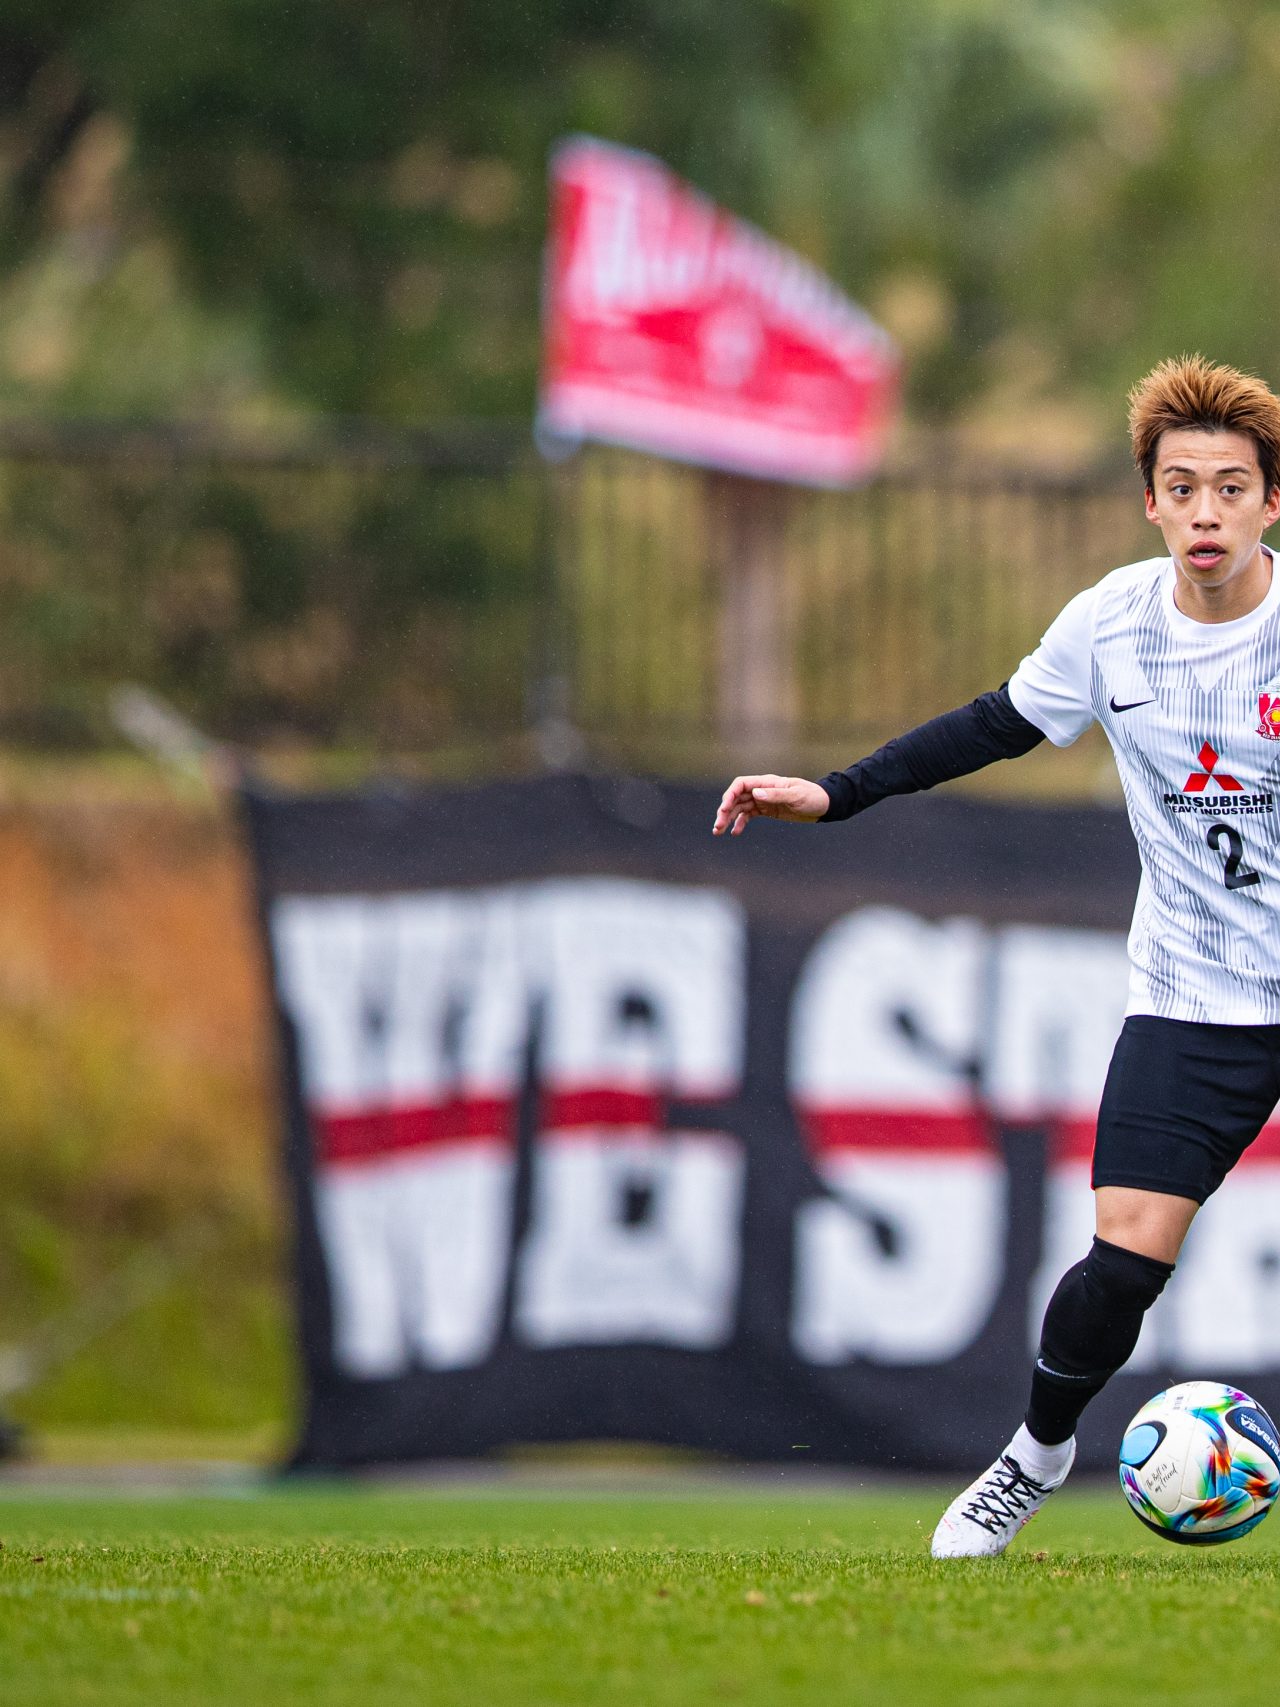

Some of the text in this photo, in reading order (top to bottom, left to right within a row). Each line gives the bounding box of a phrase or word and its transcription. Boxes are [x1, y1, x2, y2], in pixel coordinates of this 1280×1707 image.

[1163, 793, 1273, 808] MITSUBISHI
[1201, 805, 1274, 816] INDUSTRIES
[1206, 824, 1261, 890] 2
[267, 878, 747, 1380] WE
